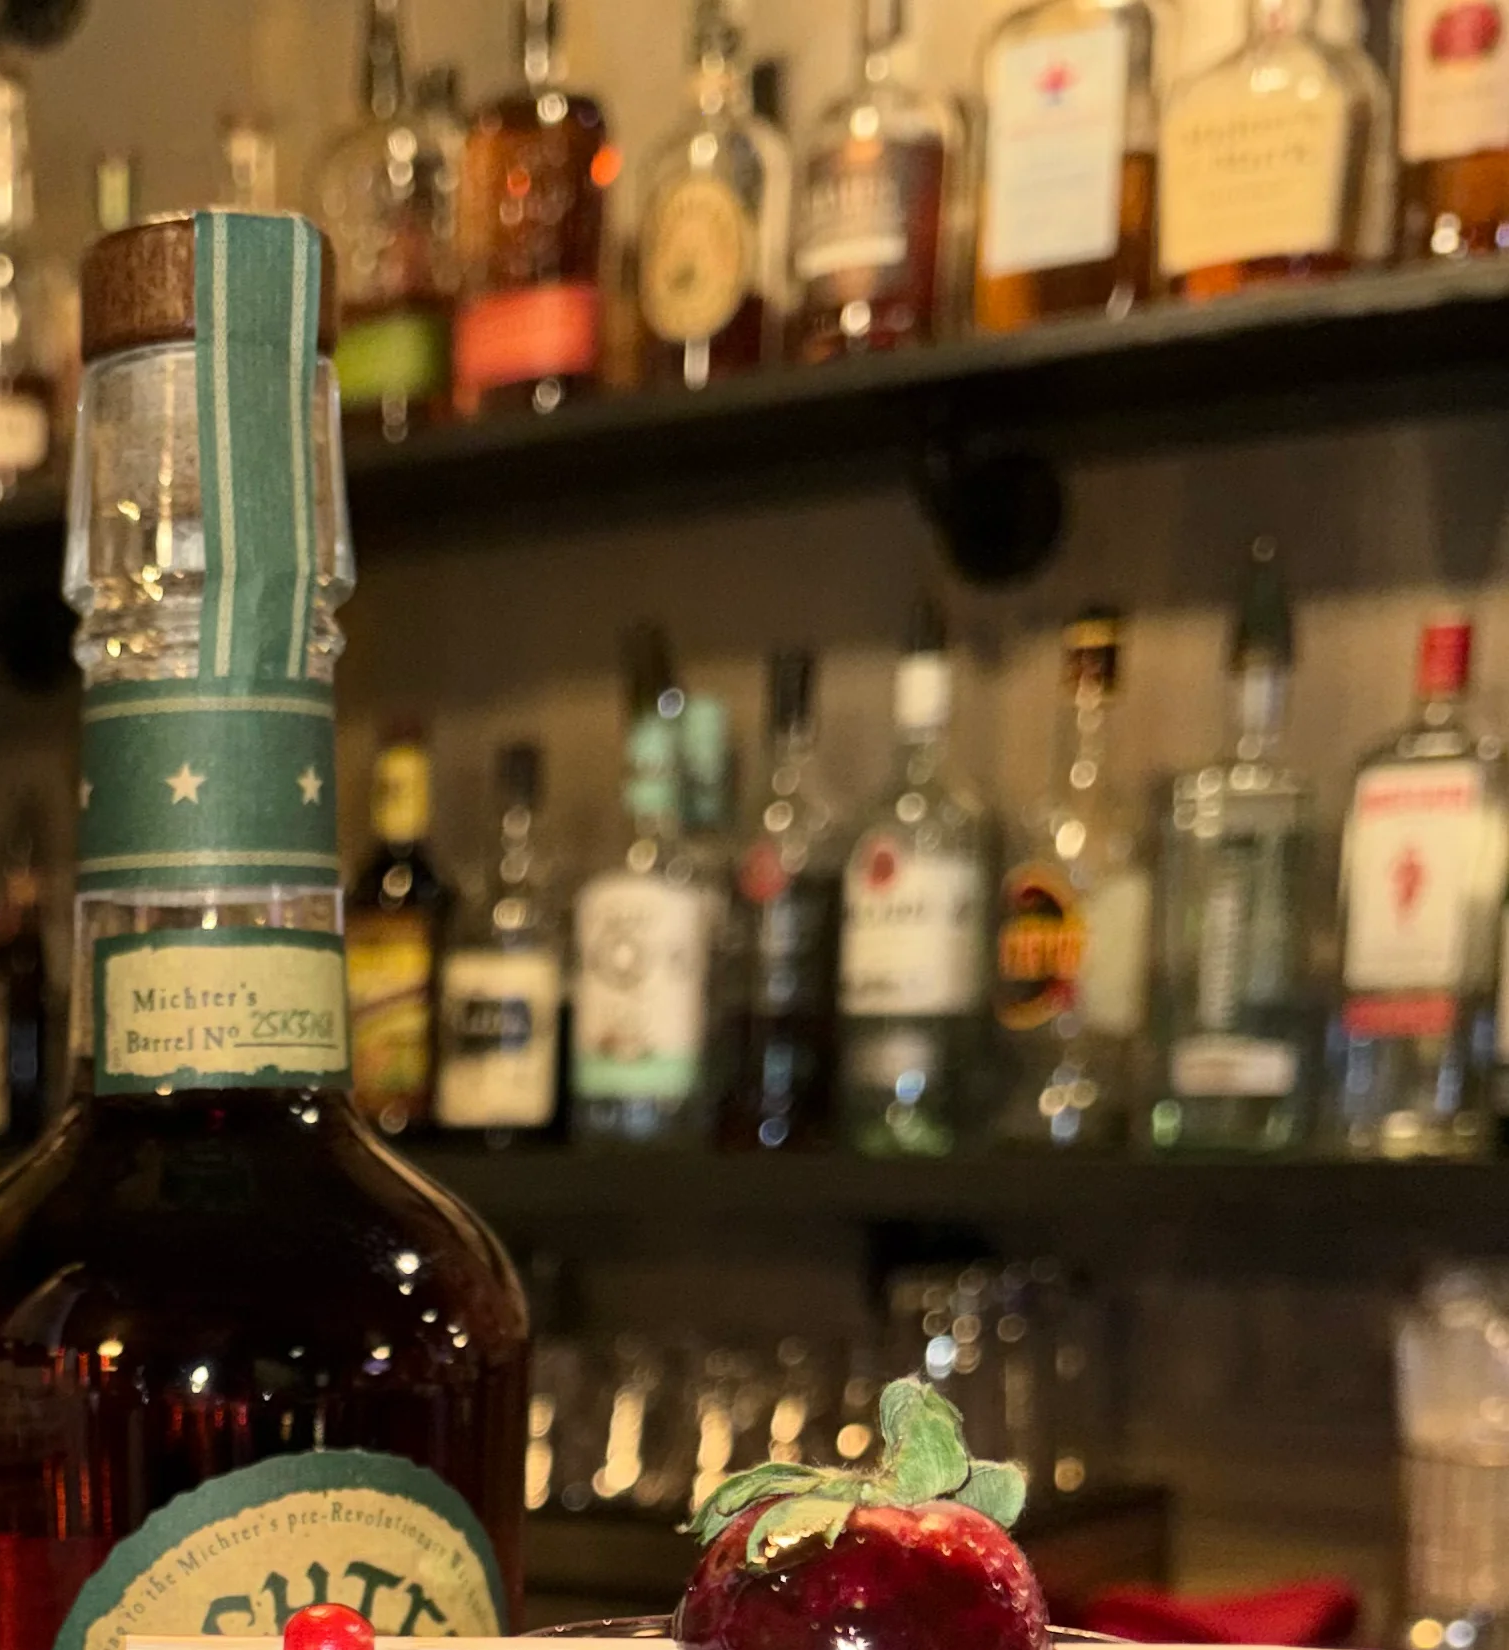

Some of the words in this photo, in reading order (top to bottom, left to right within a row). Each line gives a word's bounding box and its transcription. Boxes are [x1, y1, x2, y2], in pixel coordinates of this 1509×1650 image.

[133, 982, 258, 1014] Michter's
[126, 1027, 193, 1054] Barrel
[126, 1600, 147, 1624] to
[146, 1572, 177, 1602] the
[177, 1513, 279, 1577] Michter's
